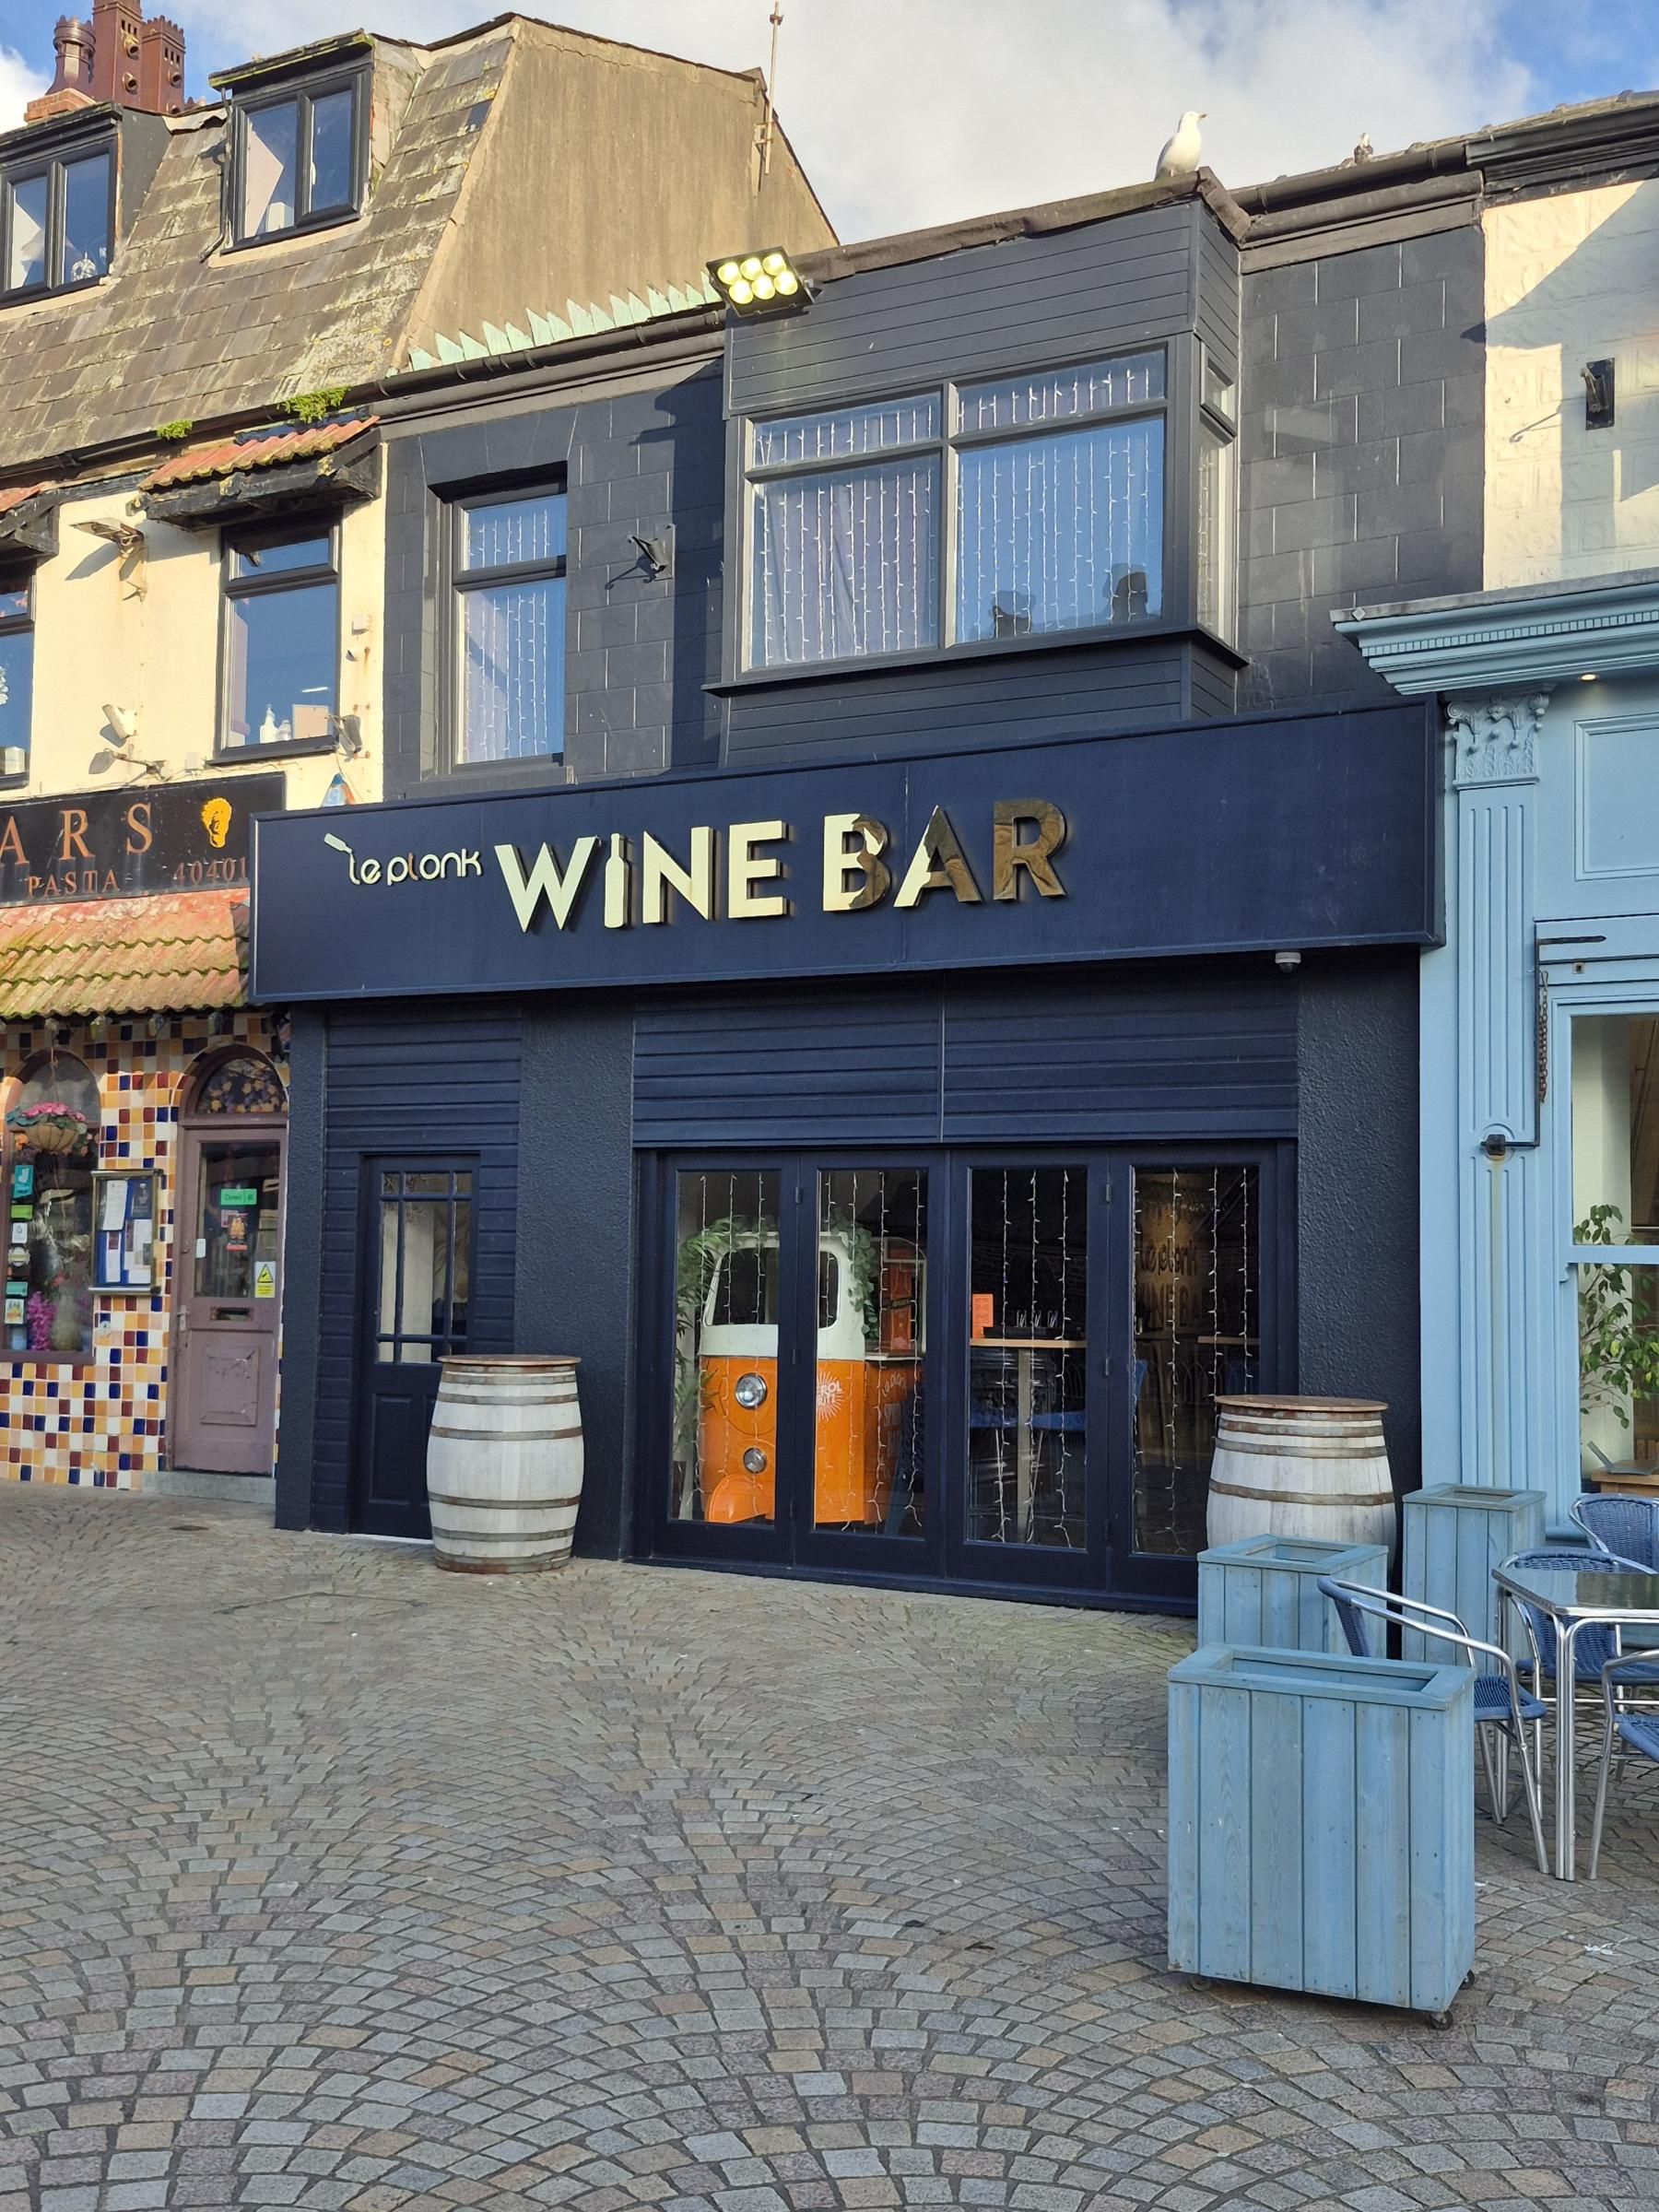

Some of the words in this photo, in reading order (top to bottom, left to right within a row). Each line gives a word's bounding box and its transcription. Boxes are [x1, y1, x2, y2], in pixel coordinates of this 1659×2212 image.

[0, 803, 153, 865] ARS
[27, 869, 120, 900] PASTA
[387, 848, 482, 886] plonk
[494, 820, 788, 934] WINE
[823, 799, 1066, 912] BAR
